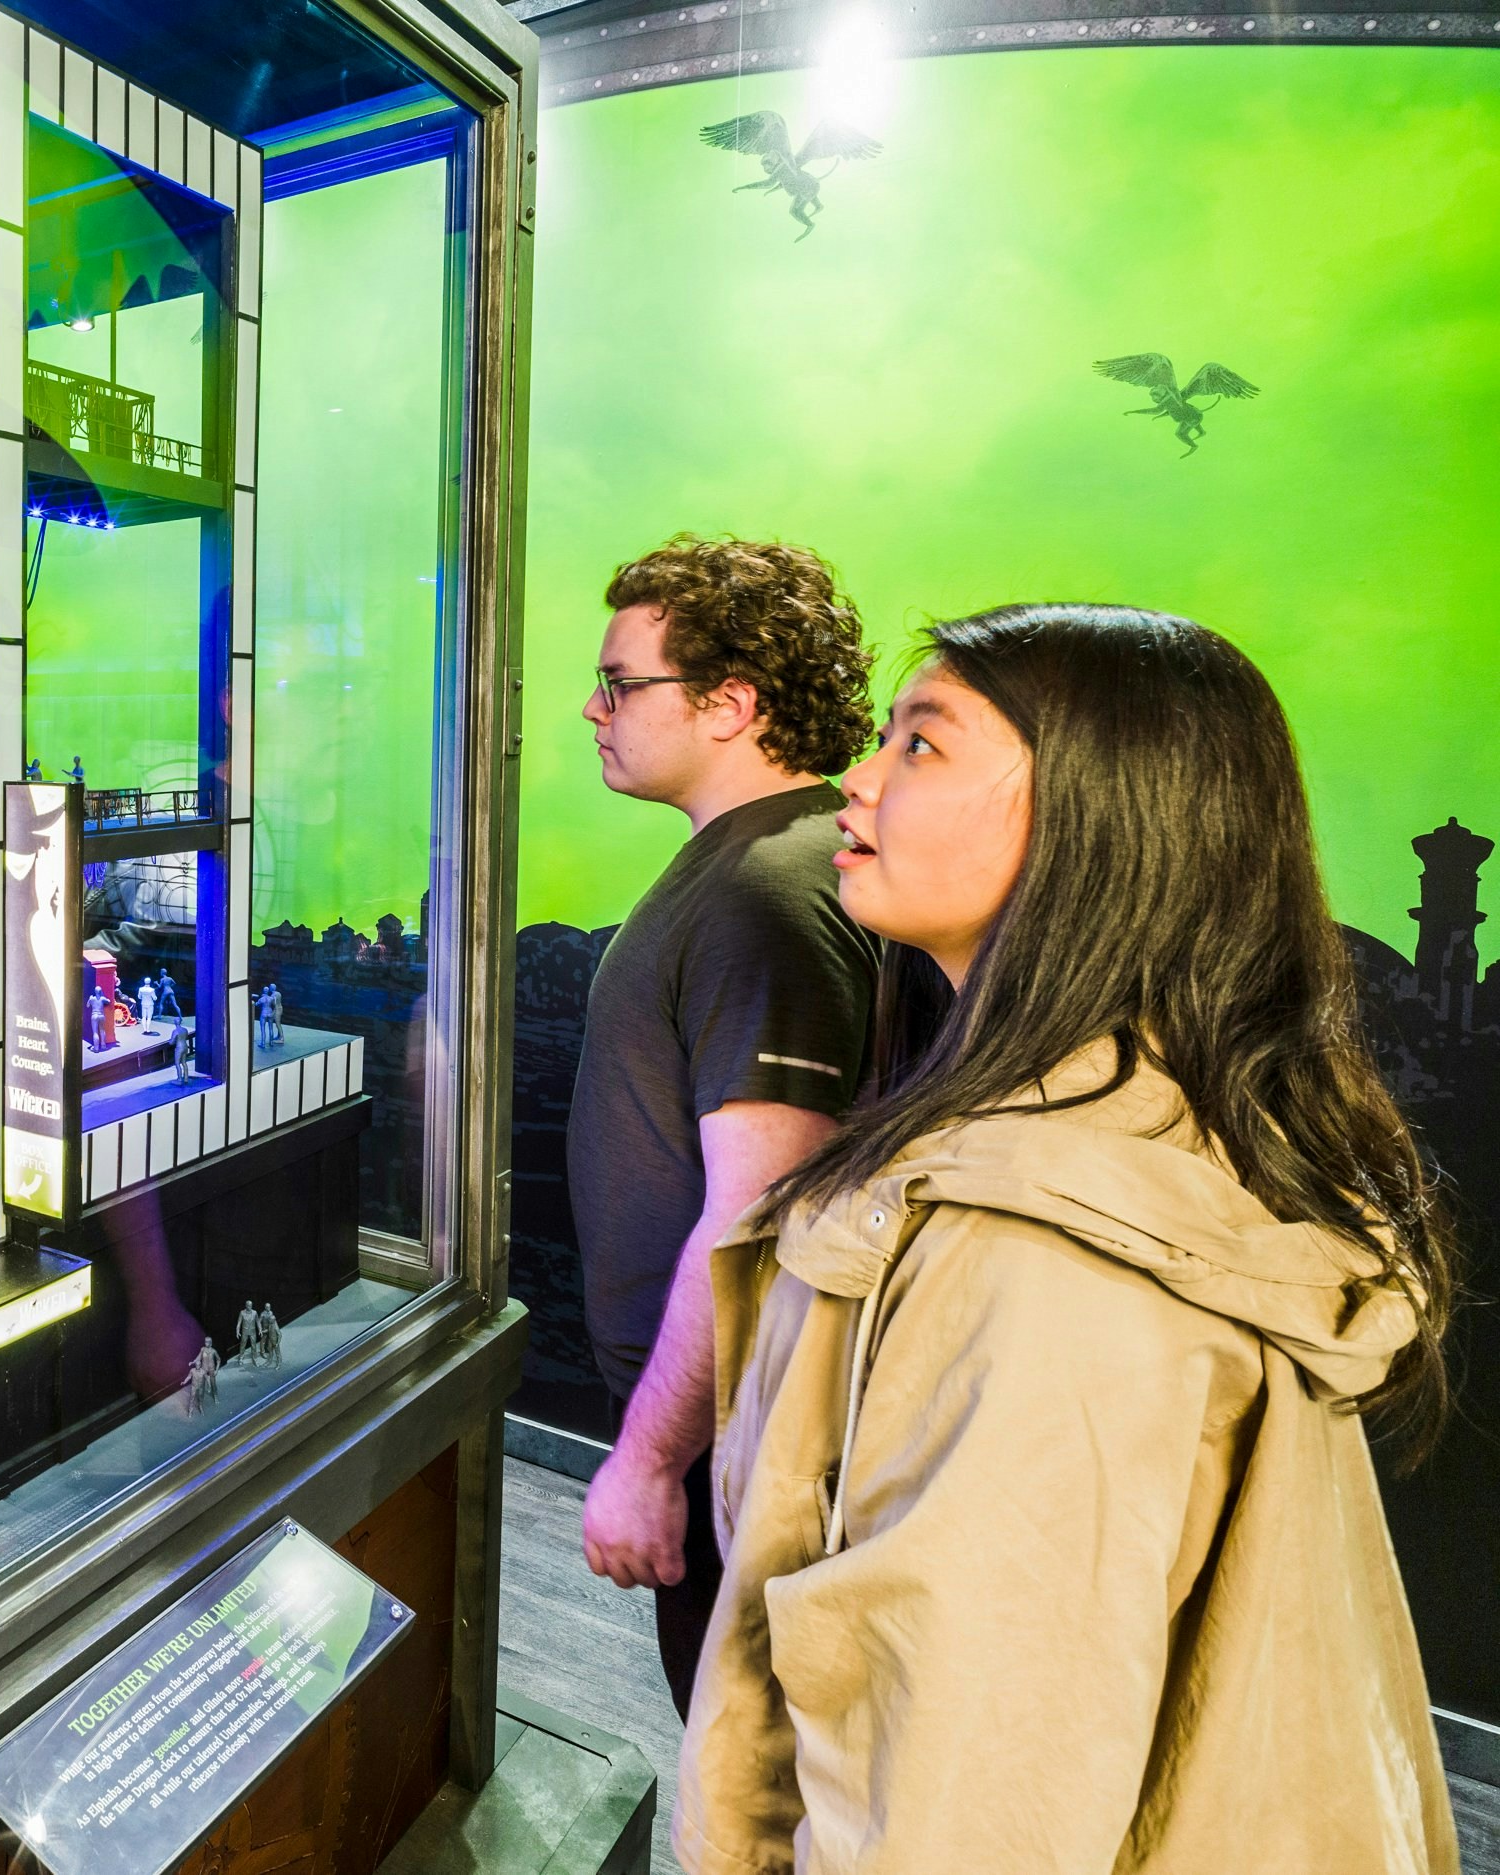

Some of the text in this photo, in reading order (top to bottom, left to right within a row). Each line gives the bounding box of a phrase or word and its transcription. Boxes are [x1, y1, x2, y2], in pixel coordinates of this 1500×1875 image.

[11, 1055, 54, 1076] Courage.
[15, 1015, 50, 1032] Brains.
[18, 1035, 49, 1053] Heart.
[14, 1153, 52, 1174] OFFICE
[21, 1142, 44, 1158] BOX
[58, 1760, 86, 1783] While
[84, 1748, 100, 1764] our
[98, 1720, 133, 1752] audience
[131, 1701, 155, 1723] enters
[151, 1686, 173, 1704] from
[168, 1676, 184, 1690] the
[178, 1647, 217, 1680] breezeway
[211, 1632, 238, 1651] below,
[233, 1622, 247, 1634] the
[243, 1603, 269, 1625] Citizens
[67, 1576, 256, 1736] TOGETHER WE'RE UNLIMITED
[76, 1814, 91, 1829] As
[86, 1785, 123, 1818] Elphaba
[117, 1756, 154, 1789] becomes
[189, 1708, 206, 1726] and
[202, 1690, 227, 1713] Glinda
[224, 1675, 243, 1694] more
[240, 1654, 269, 1680] popular,
[264, 1640, 283, 1657] team
[277, 1622, 303, 1643] leaders
[82, 1770, 96, 1782] in
[91, 1754, 114, 1774] high
[112, 1739, 131, 1760] gear
[128, 1732, 140, 1743] to
[137, 1710, 164, 1735] deliver
[161, 1705, 171, 1714] a
[167, 1671, 210, 1709] consistently
[206, 1646, 240, 1674] engaging
[234, 1634, 250, 1650] and
[247, 1624, 262, 1639] safe
[148, 1639, 327, 1809] all while our talented Understudies, Swings, and Standbys
[99, 1812, 116, 1828] the
[111, 1794, 135, 1814] Time
[130, 1769, 163, 1798] Dragon
[160, 1751, 182, 1772] clock
[178, 1744, 189, 1755] to
[187, 1722, 213, 1747] ensure
[209, 1709, 228, 1726] that
[223, 1699, 239, 1713] the
[235, 1690, 248, 1702] Oz
[243, 1677, 263, 1694] Map
[258, 1664, 274, 1680] will
[270, 1659, 281, 1672] go
[278, 1651, 291, 1662] up
[287, 1638, 304, 1654] each
[187, 1670, 316, 1793] rehearse tirelessly with our creative team.
